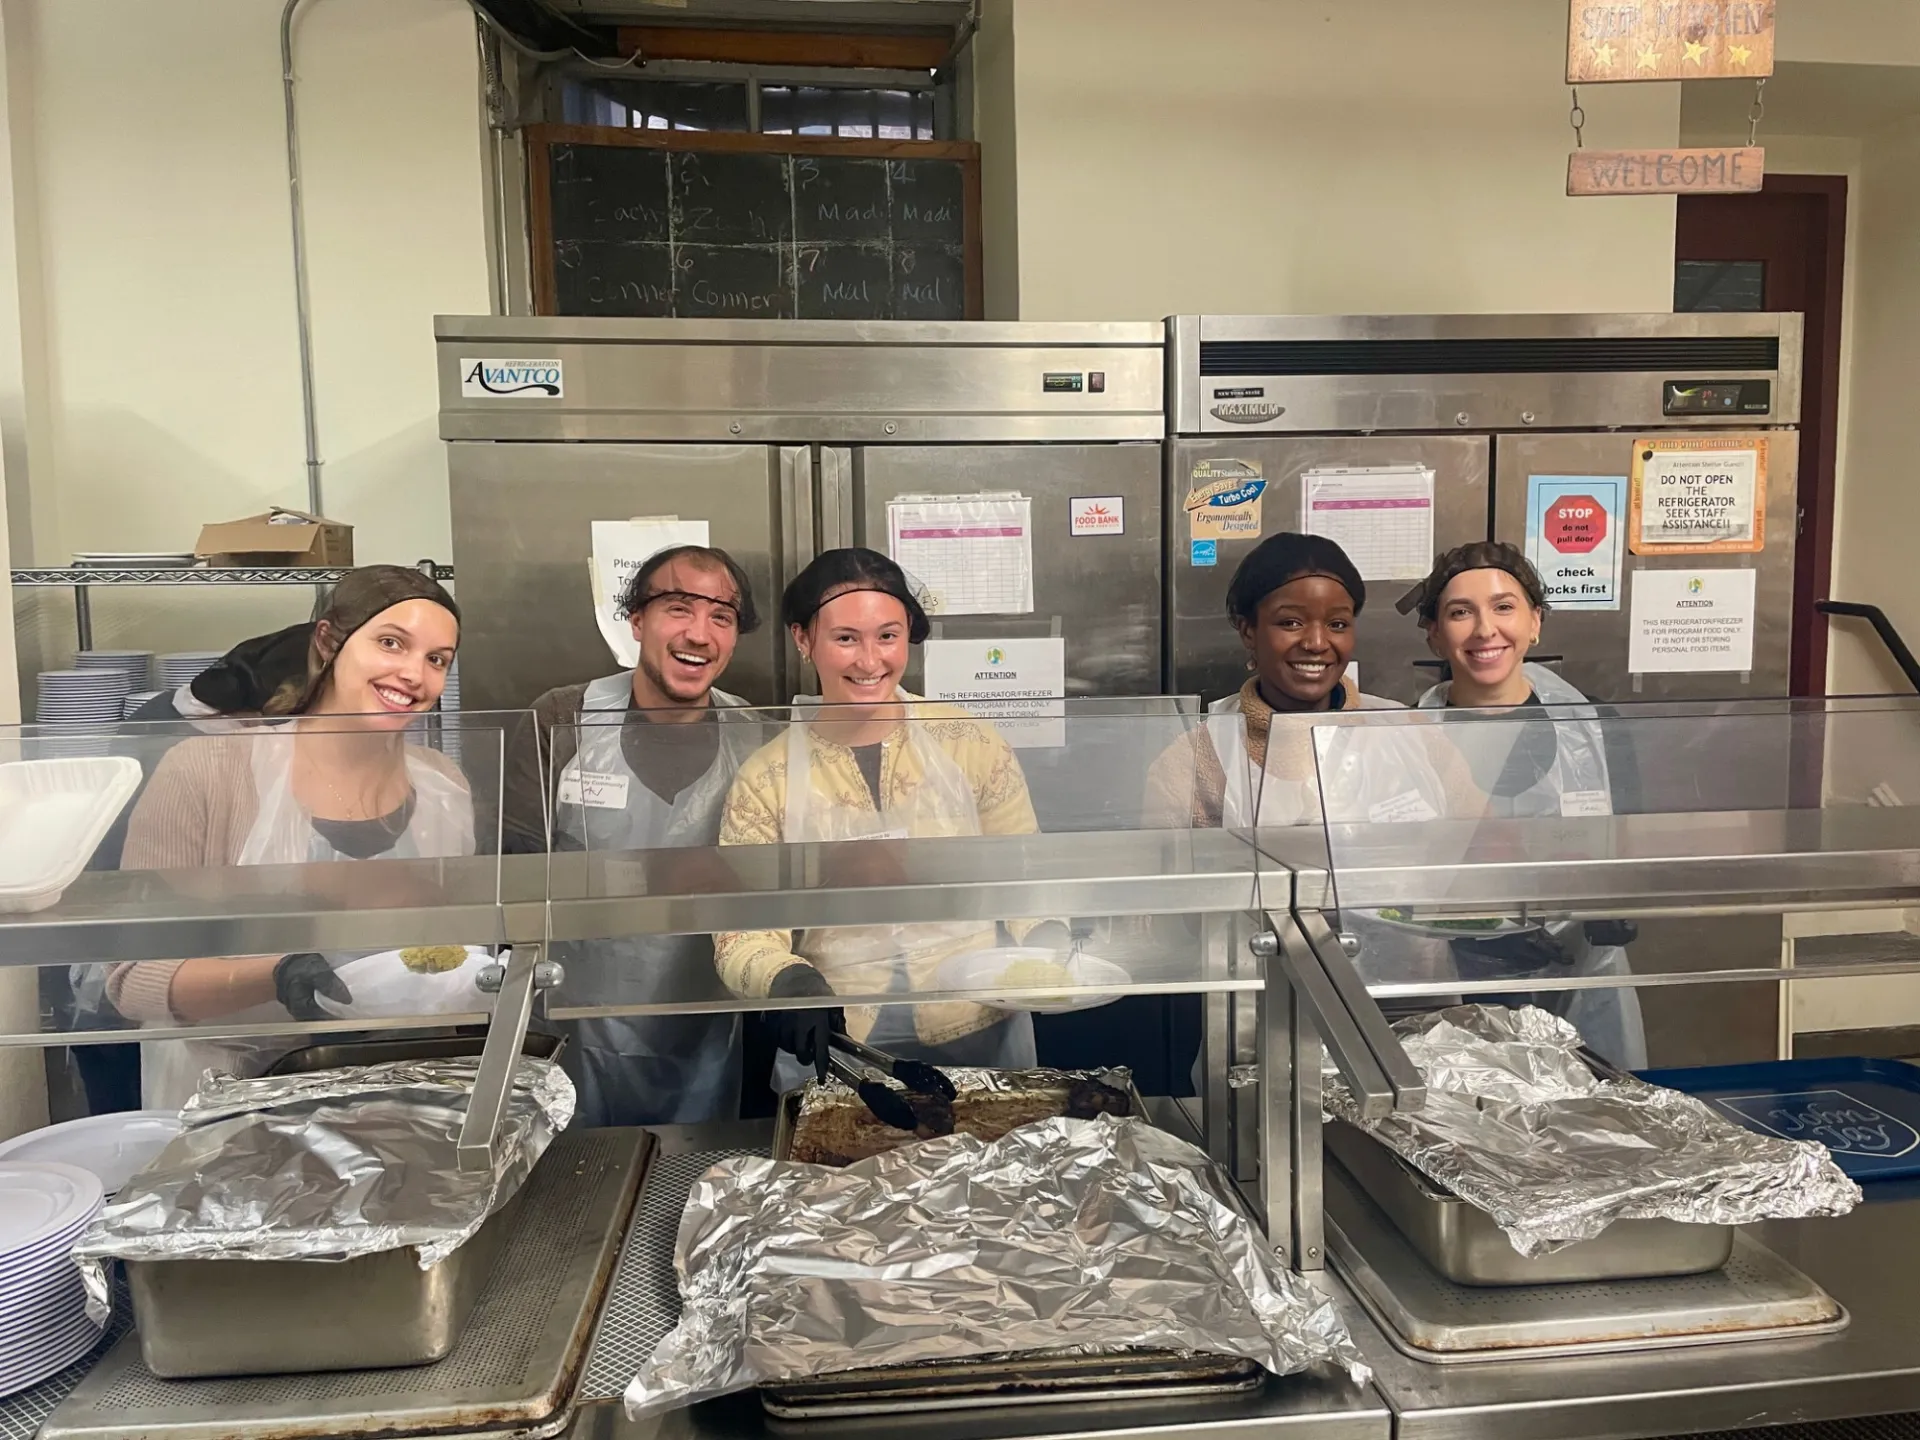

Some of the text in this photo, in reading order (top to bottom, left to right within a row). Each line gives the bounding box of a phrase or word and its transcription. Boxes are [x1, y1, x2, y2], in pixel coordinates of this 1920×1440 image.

[1587, 151, 1744, 188] WELCOME
[676, 246, 694, 271] 6
[798, 249, 820, 274] 7
[504, 360, 560, 368] REFRIGERATION
[464, 361, 560, 388] AVANTCO
[1217, 403, 1279, 416] MAXIMUM
[1192, 469, 1221, 478] QUALITY
[1661, 475, 1734, 485] DO NOT OPEN
[1218, 484, 1259, 505] Turbo Cool
[1686, 486, 1707, 496] THE
[1658, 497, 1736, 507] REFRIGERATOR
[1196, 511, 1253, 523] Ergonomically
[1558, 508, 1594, 519] STOP
[1666, 508, 1727, 518] SEEK STAFF
[1075, 515, 1119, 525] FOOD BANK
[1662, 519, 1731, 529] ASSISTANCE!!
[1222, 521, 1259, 532] Designed
[1562, 524, 1589, 532] do not
[1556, 535, 1594, 545] pull door
[1556, 566, 1595, 578] check
[1581, 584, 1607, 594] first
[1675, 600, 1714, 608] ATTENTION
[1668, 627, 1703, 635] PROGRAM
[1686, 636, 1701, 644] FOR
[1690, 645, 1709, 653] FOOD
[974, 671, 1017, 680] ATTENTION
[939, 692, 956, 700] THIS
[967, 701, 1006, 709] PROGRAM
[1007, 700, 1029, 708] FOOD
[1768, 1103, 1881, 1132] John
[1812, 1122, 1891, 1151] Jay
